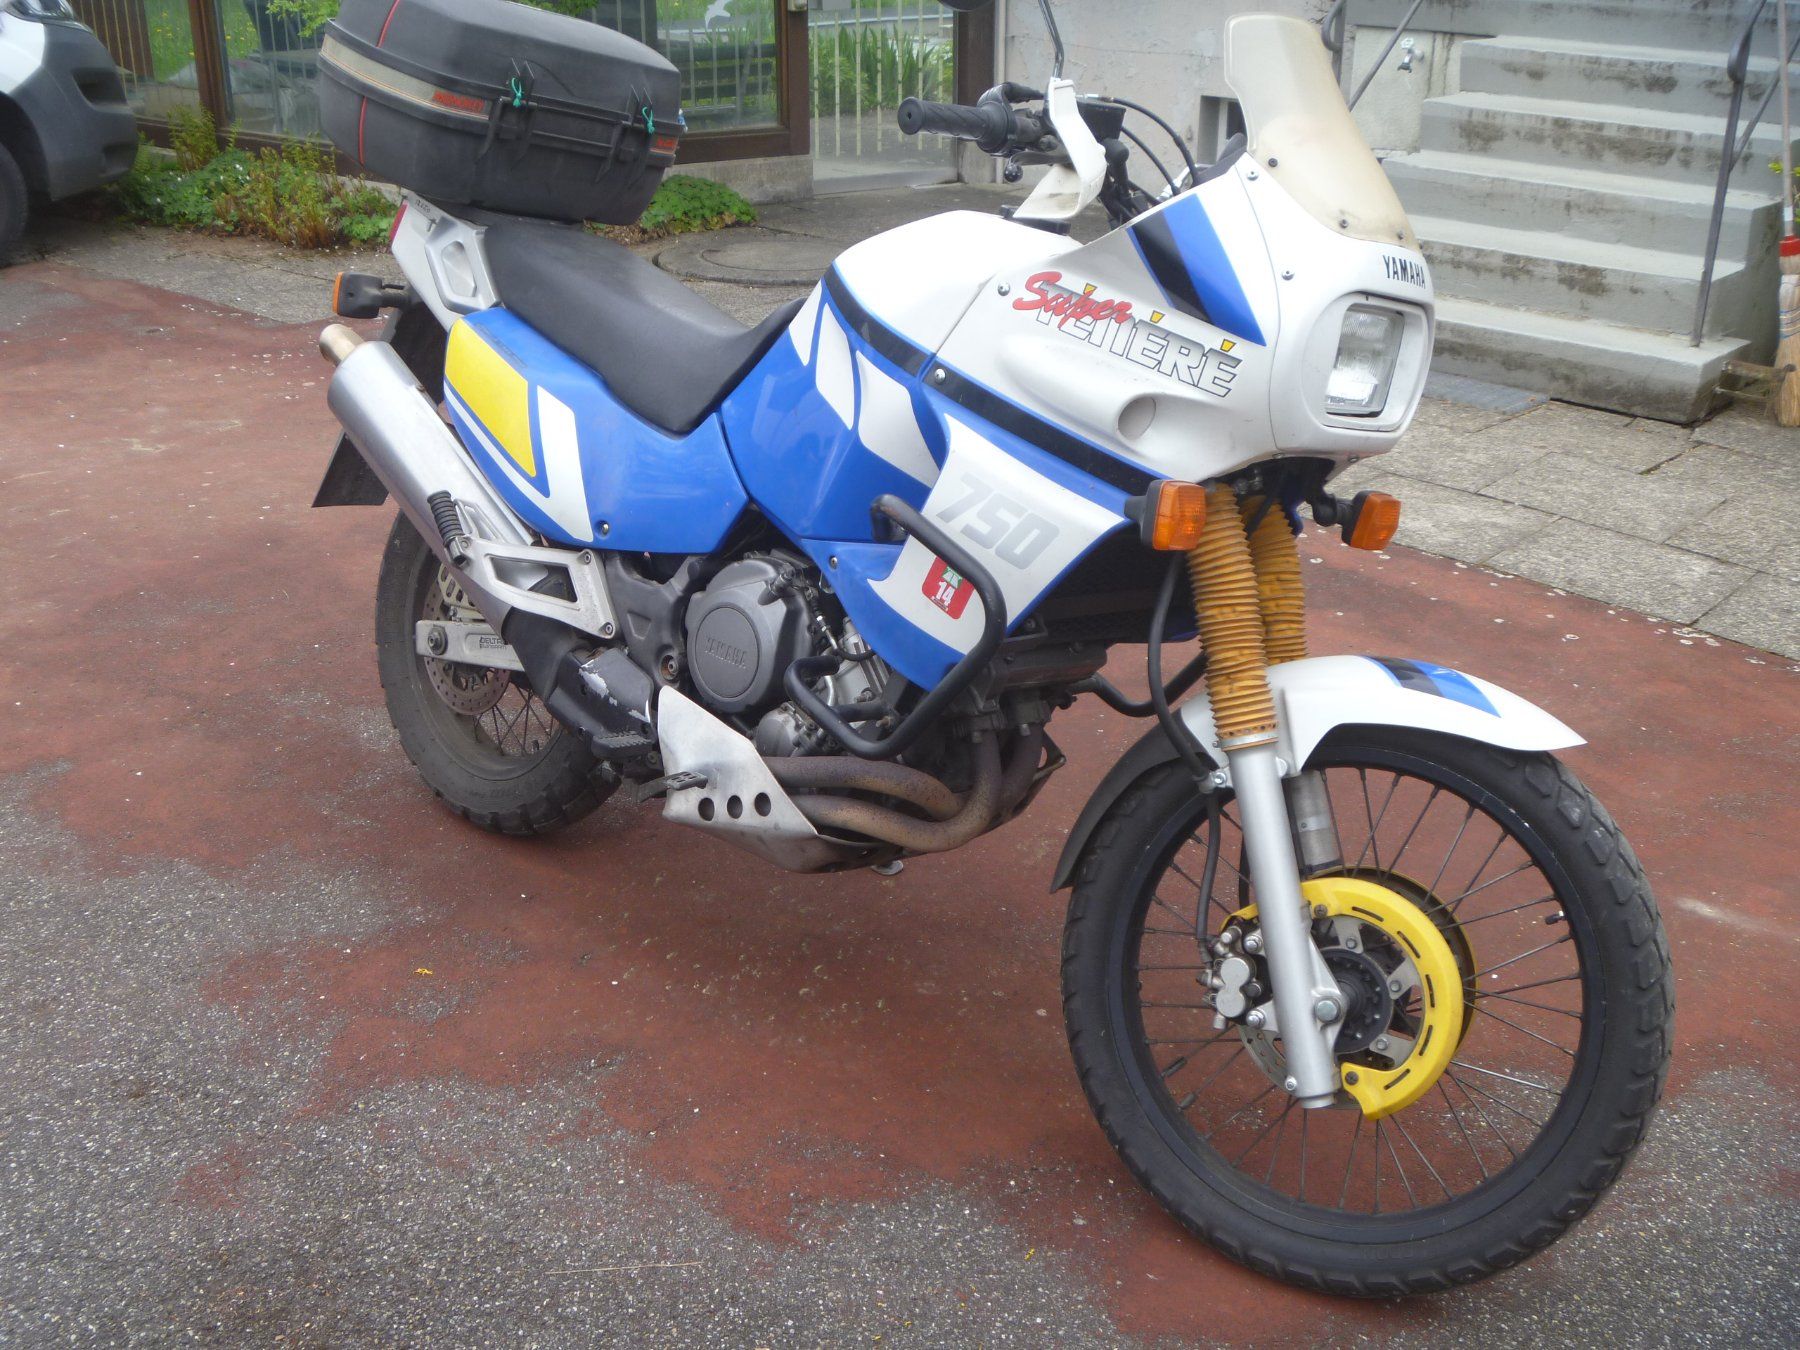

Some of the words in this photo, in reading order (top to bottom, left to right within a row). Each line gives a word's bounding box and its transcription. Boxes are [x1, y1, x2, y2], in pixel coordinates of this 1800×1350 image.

[1382, 254, 1426, 289] YAMAHA
[1012, 271, 1133, 329] Super
[935, 471, 1061, 570] 750
[935, 581, 956, 607] 14
